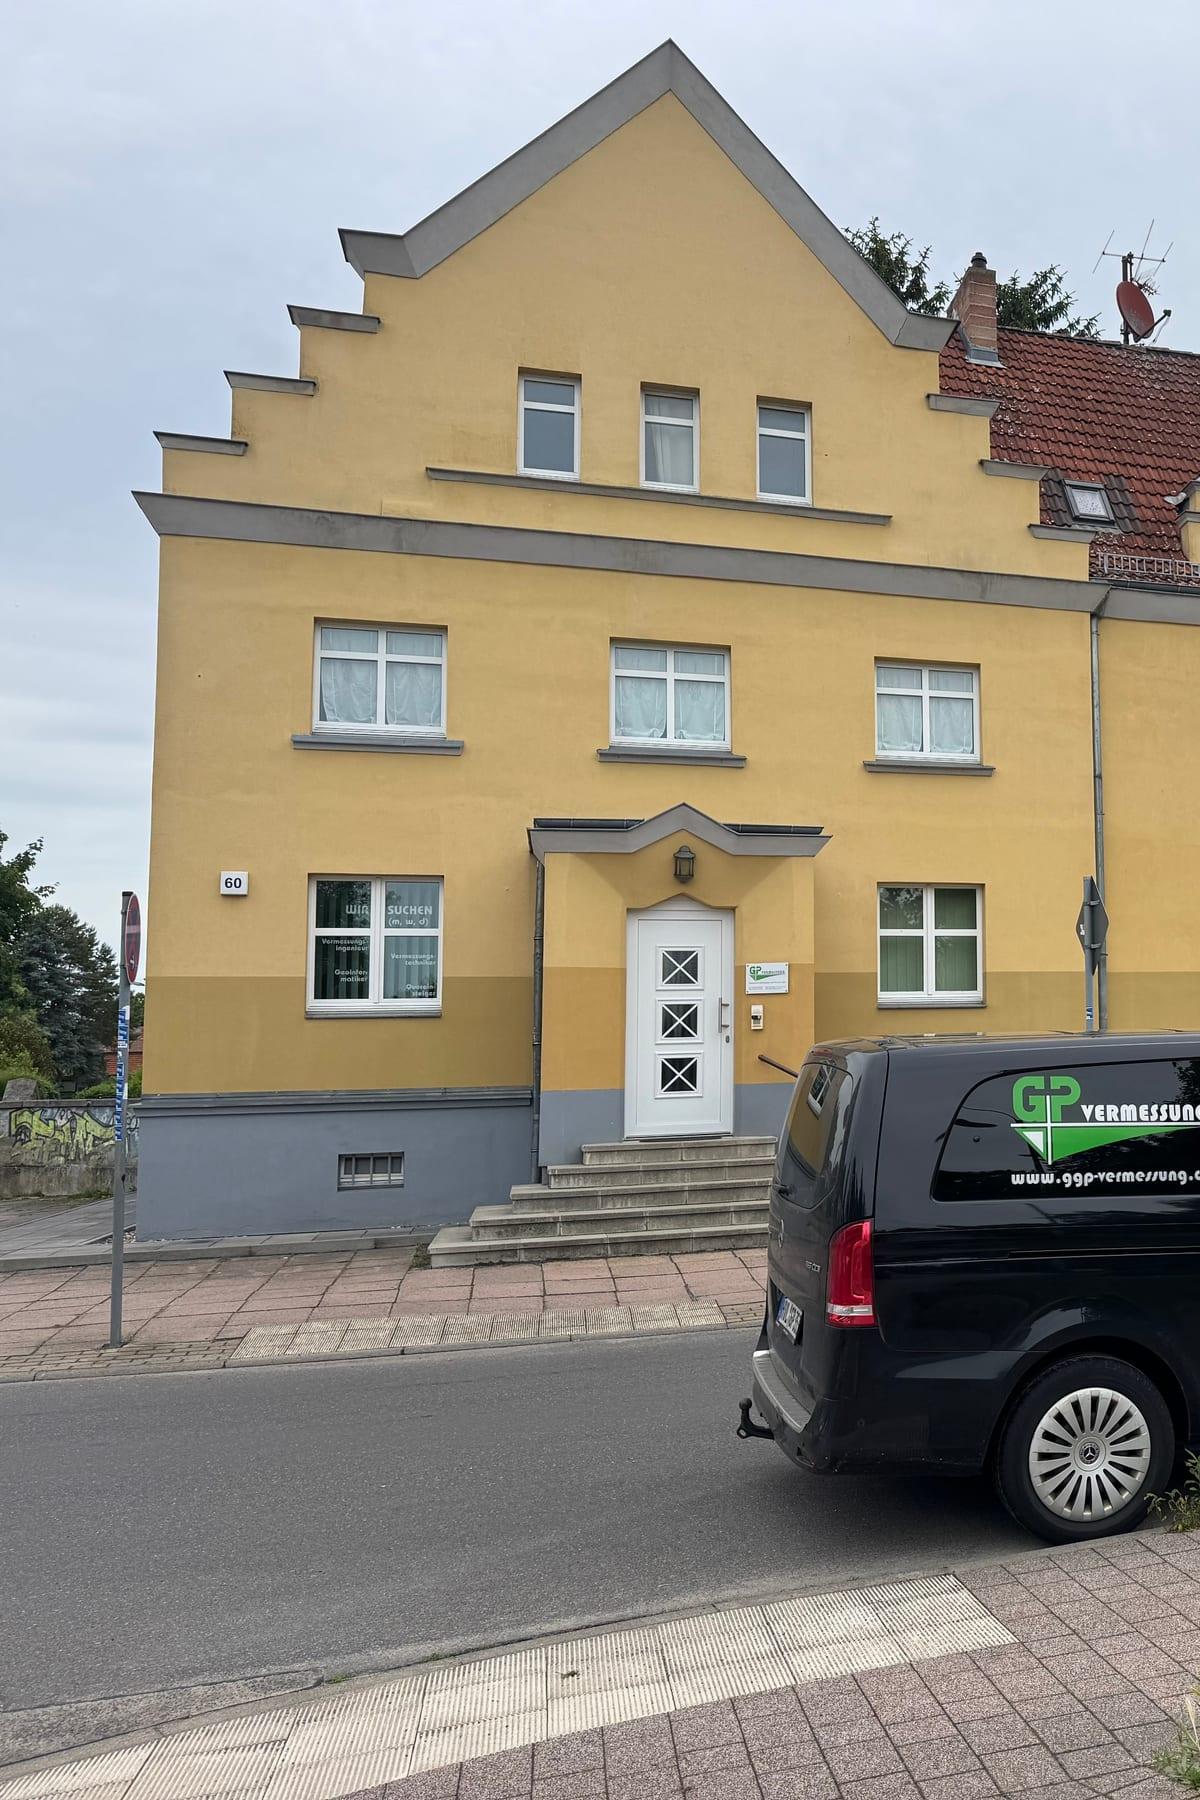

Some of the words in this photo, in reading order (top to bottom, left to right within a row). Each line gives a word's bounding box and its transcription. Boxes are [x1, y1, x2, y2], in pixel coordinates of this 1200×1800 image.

[224, 877, 242, 889] 60
[345, 905, 369, 915] WIR
[387, 905, 433, 915] SUCHEN
[419, 918, 429, 927] d)
[750, 966, 762, 975] GP
[1012, 1075, 1081, 1122] GP
